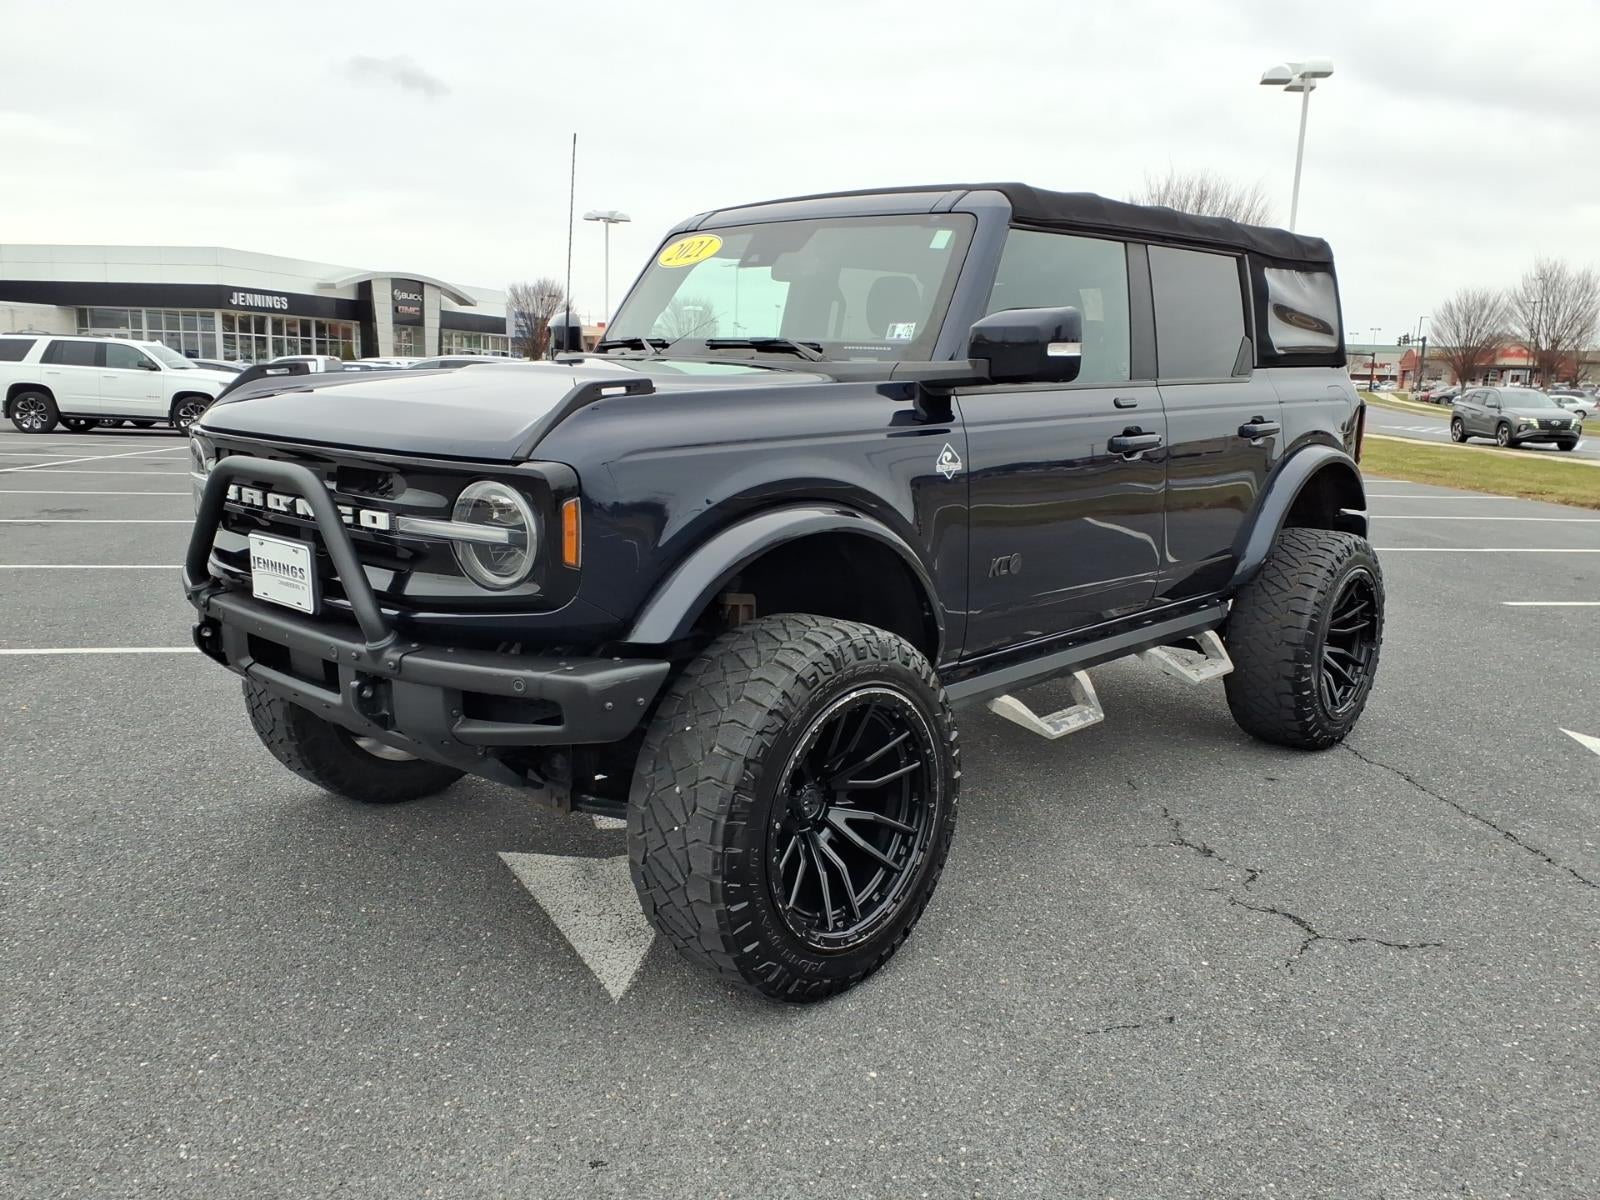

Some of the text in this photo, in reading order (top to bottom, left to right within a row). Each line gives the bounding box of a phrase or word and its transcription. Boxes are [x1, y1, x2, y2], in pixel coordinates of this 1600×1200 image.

[664, 240, 715, 262] 2021
[231, 292, 288, 309] JENNINGS
[401, 292, 423, 301] BUICK
[252, 556, 306, 580] JENNINGS
